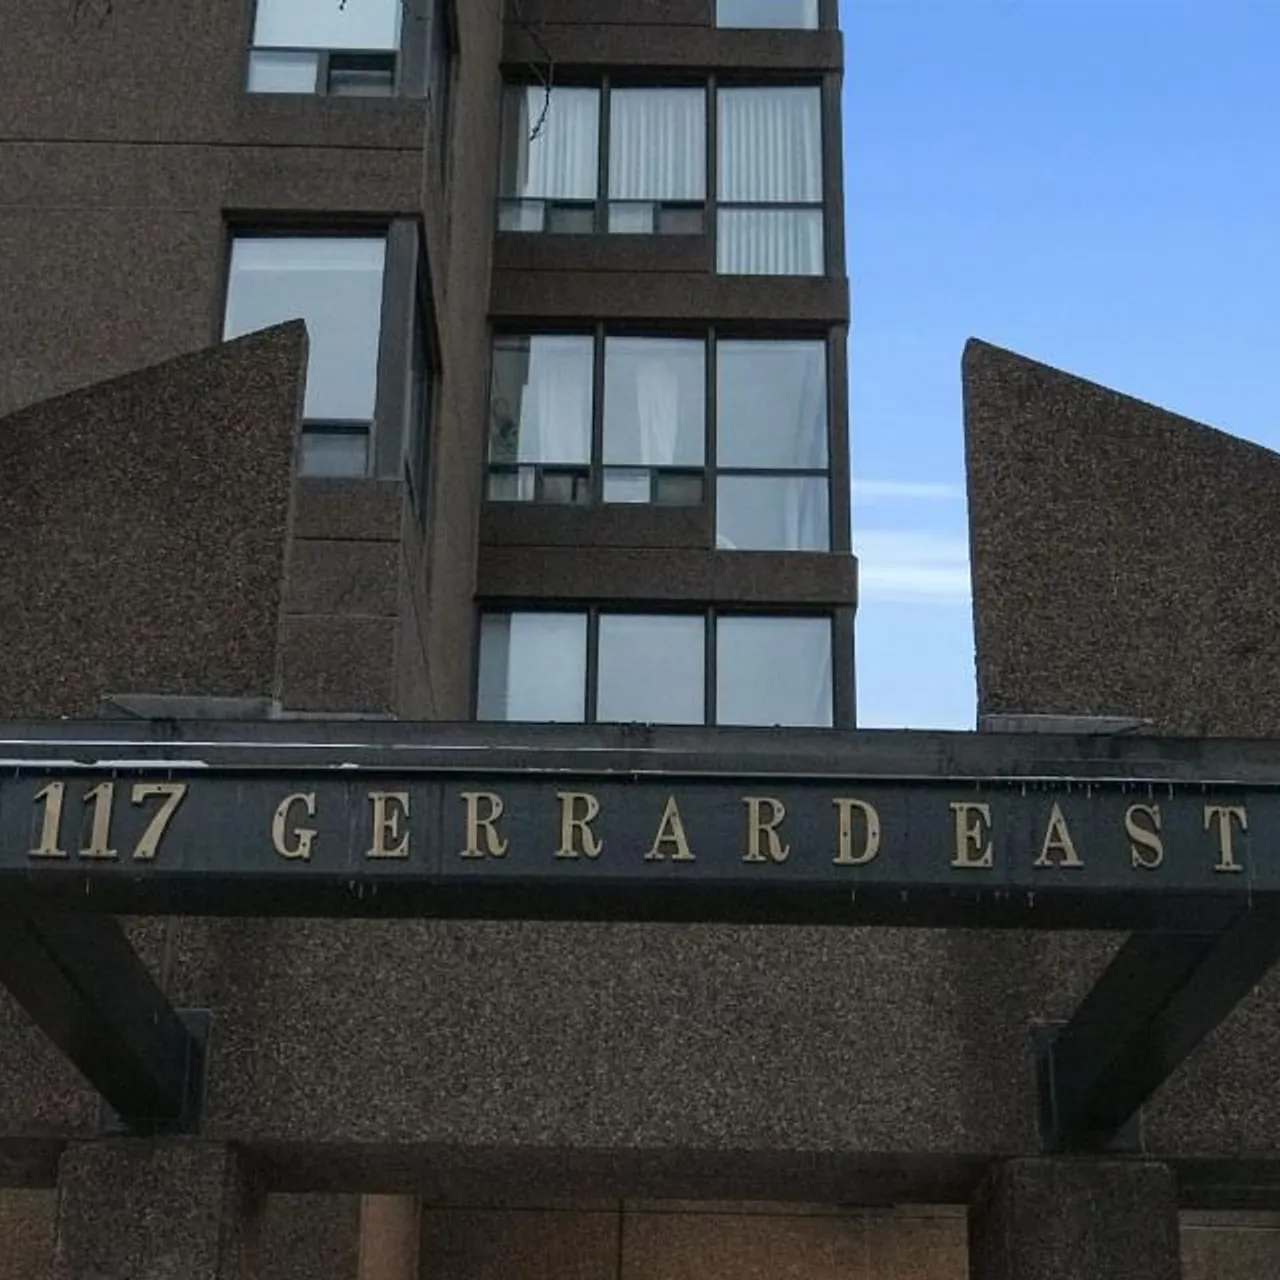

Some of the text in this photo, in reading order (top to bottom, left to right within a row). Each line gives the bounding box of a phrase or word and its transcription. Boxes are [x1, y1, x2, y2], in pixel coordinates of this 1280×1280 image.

[27, 781, 1248, 873] 117 GERRARD EAST
